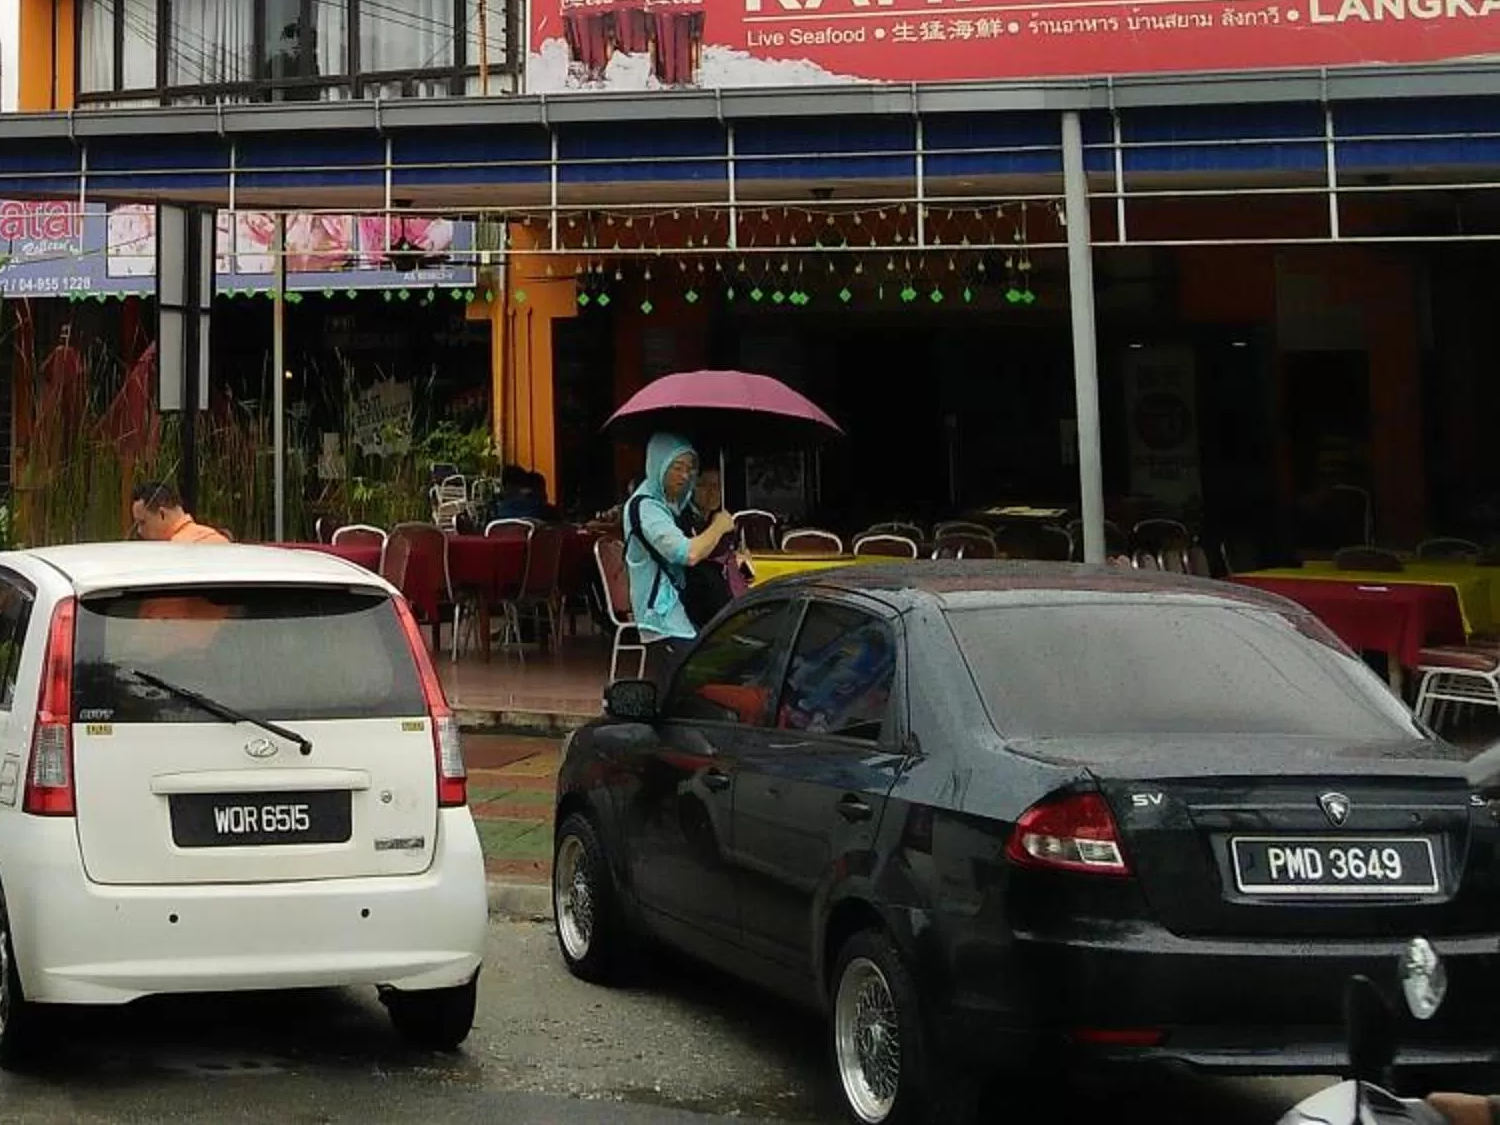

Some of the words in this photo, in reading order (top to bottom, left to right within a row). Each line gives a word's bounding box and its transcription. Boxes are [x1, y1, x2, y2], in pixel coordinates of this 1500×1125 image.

[747, 28, 784, 47] Live
[790, 26, 866, 45] Seafood
[892, 20, 1003, 43] 生猛海鮮
[1132, 792, 1164, 807] SV
[261, 804, 310, 832] 6515
[1267, 848, 1323, 880] PMD
[1331, 847, 1403, 880] 3649
